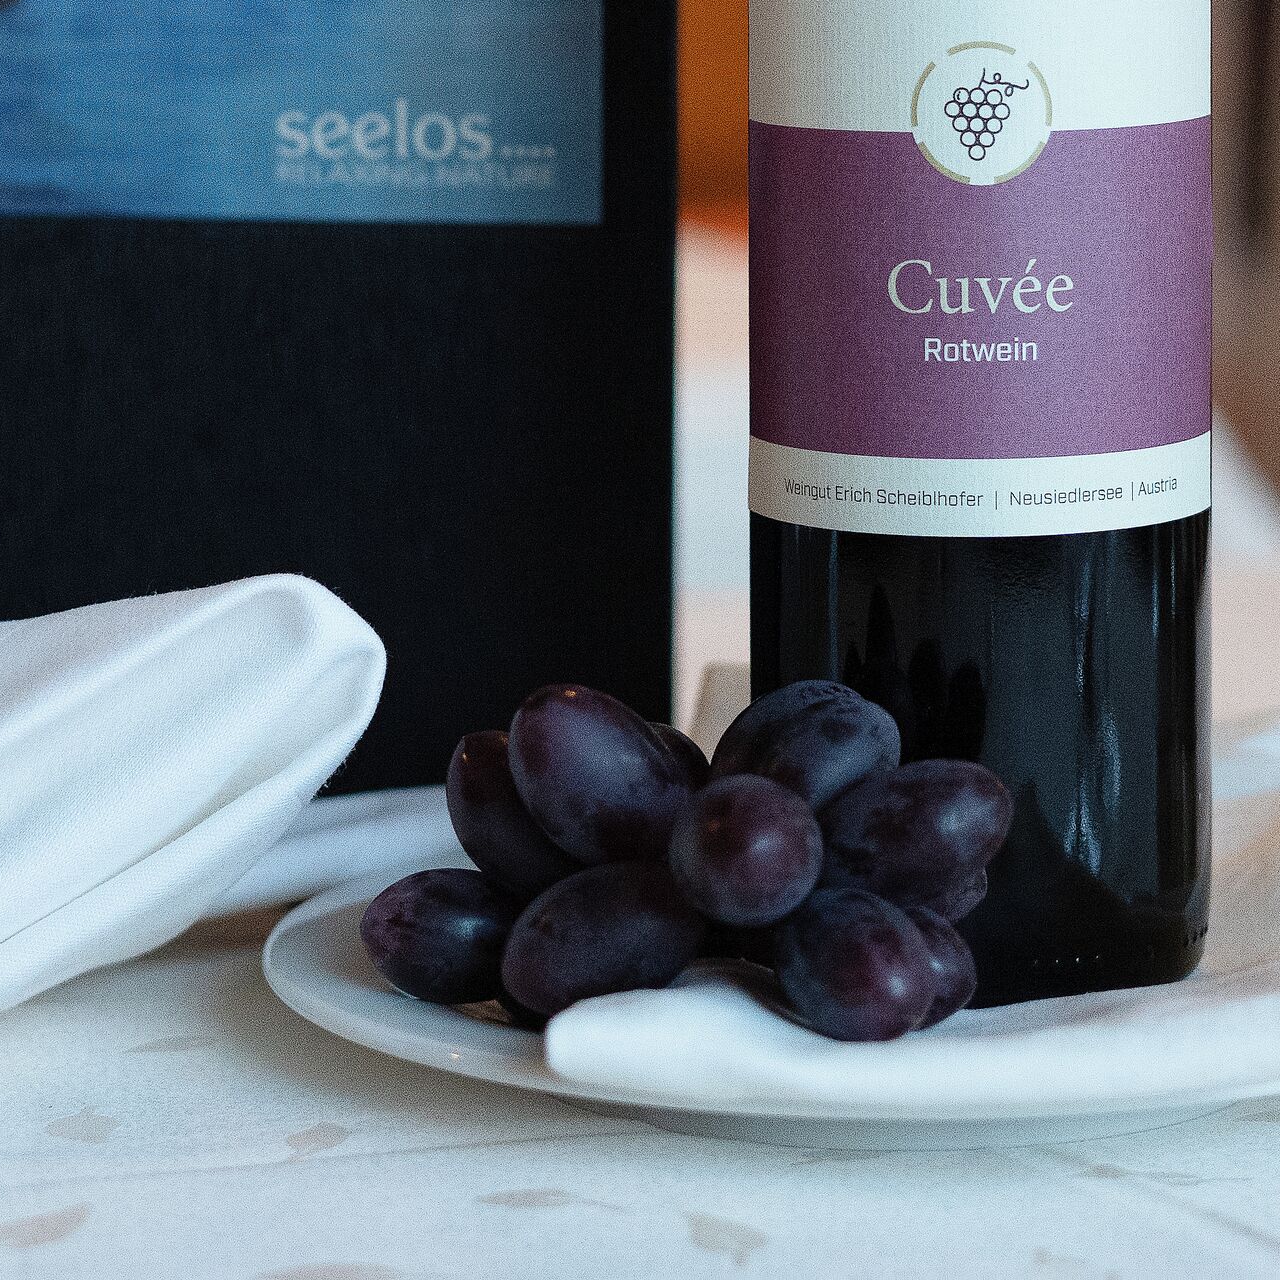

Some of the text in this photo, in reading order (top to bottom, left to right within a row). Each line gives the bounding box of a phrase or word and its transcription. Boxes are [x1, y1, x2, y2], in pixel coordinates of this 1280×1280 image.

[275, 96, 494, 161] seelos
[887, 258, 1074, 314] Cuvée
[924, 338, 1037, 361] Rotwein
[784, 475, 1178, 507] Weingut Erich Scheiblhofer Neusiedlersee Austria
